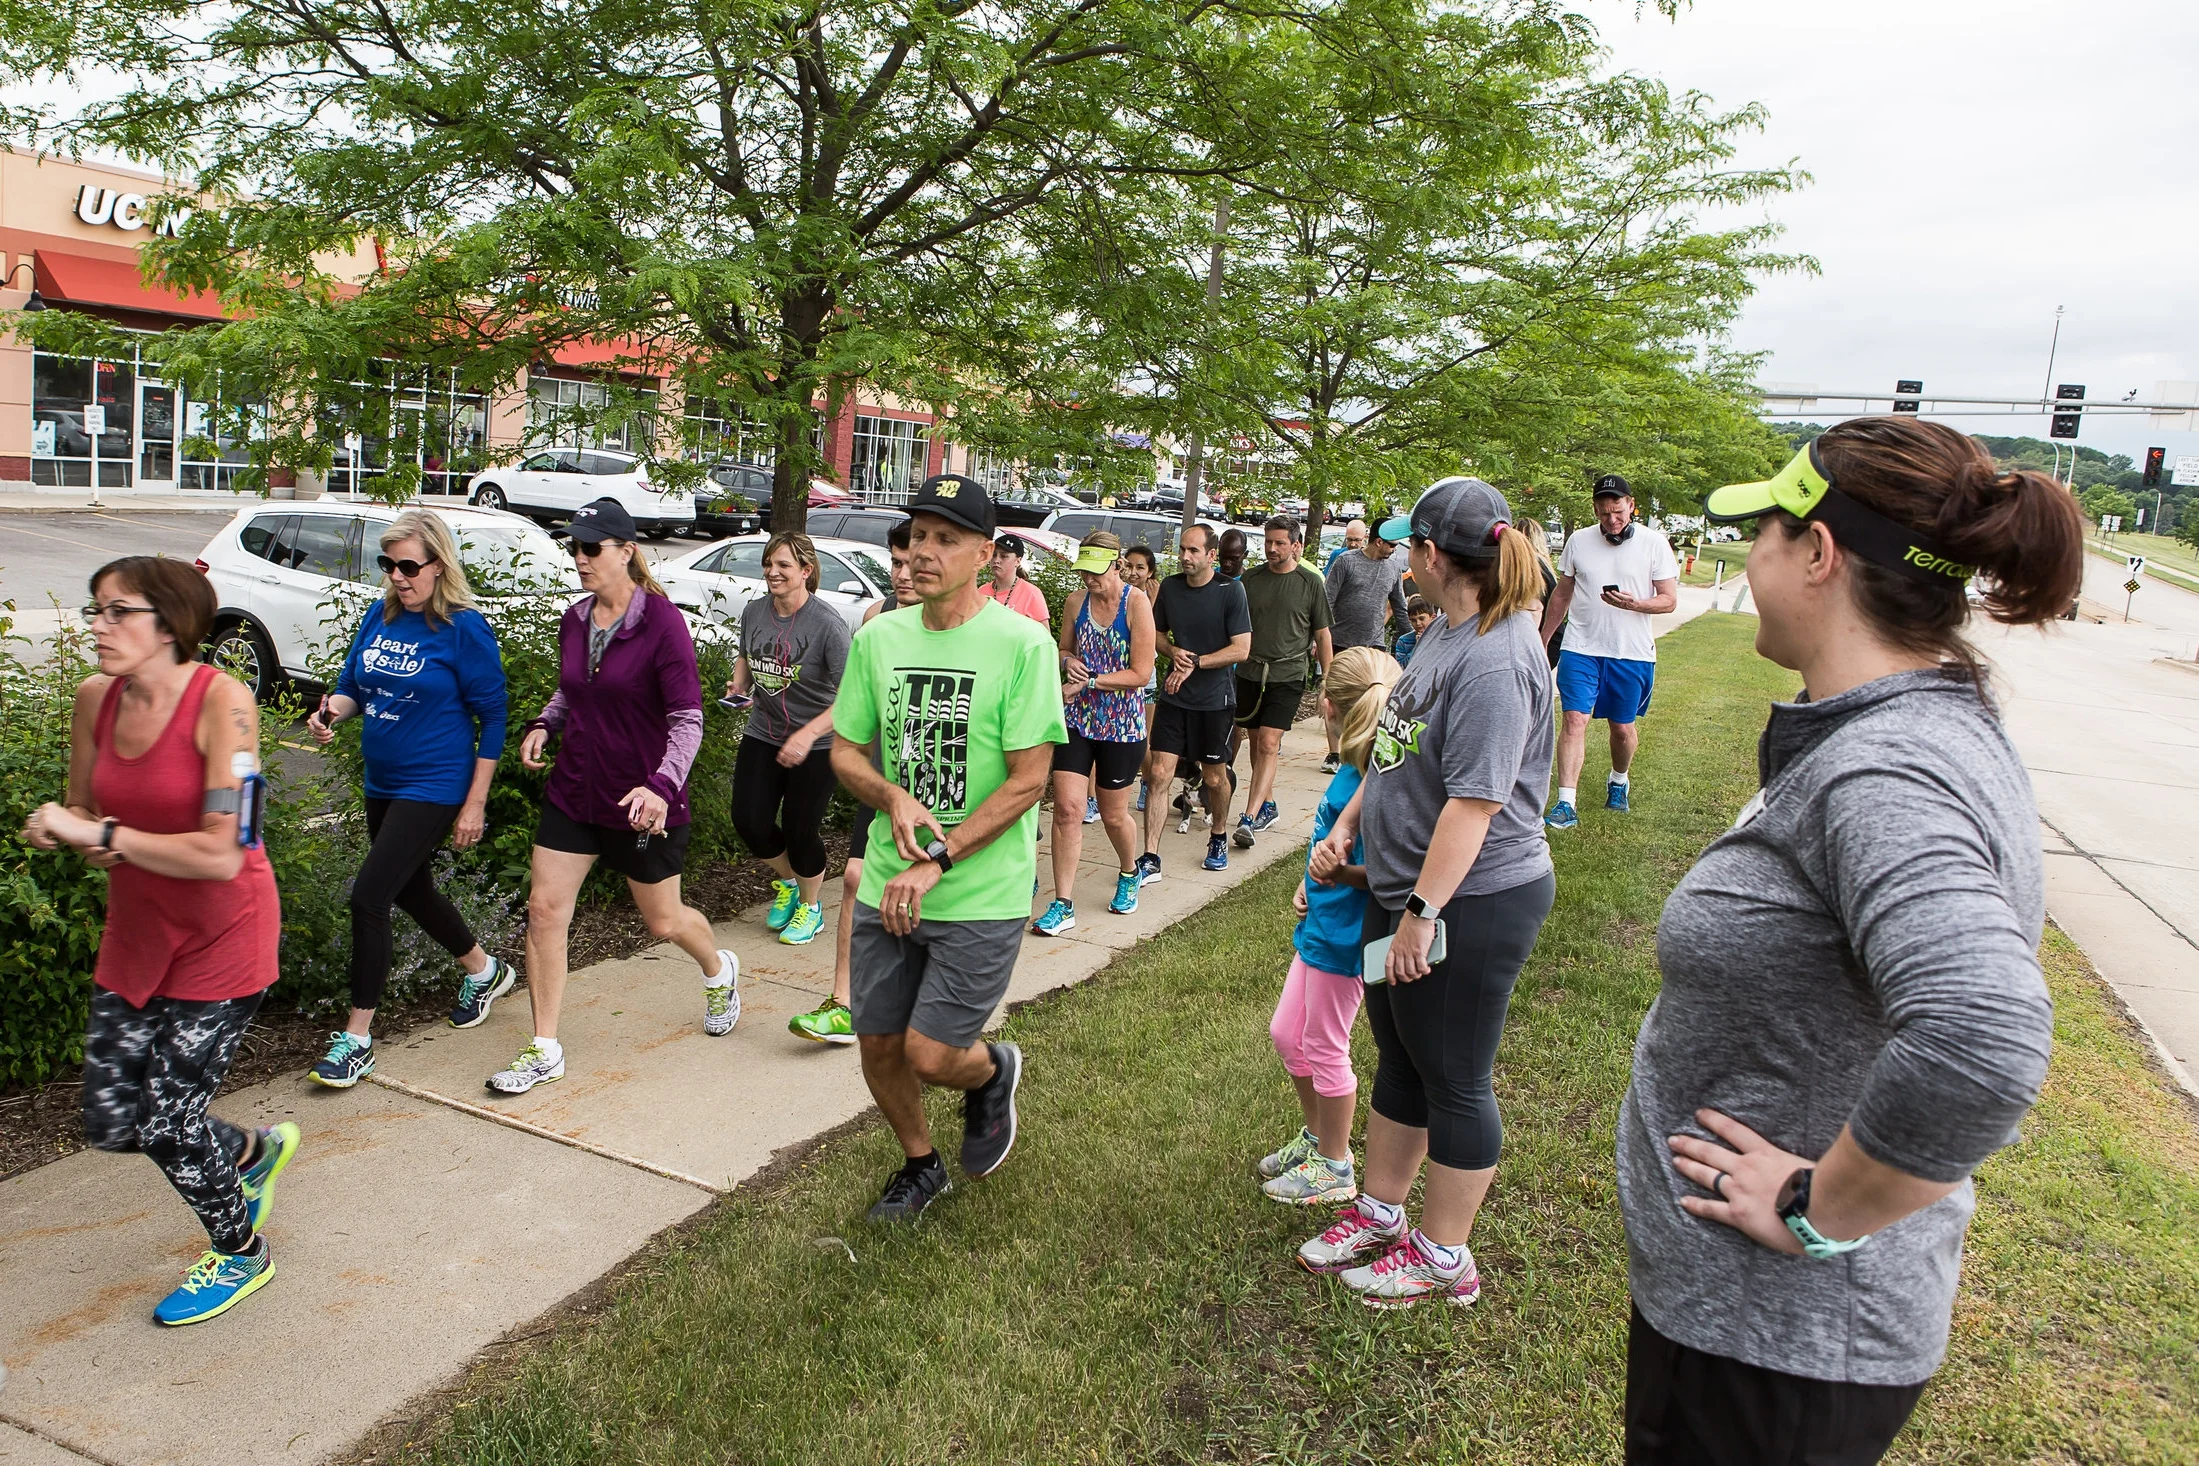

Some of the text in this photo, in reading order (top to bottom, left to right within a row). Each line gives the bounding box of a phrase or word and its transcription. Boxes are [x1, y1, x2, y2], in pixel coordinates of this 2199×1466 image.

[370, 635, 420, 655] heart
[376, 655, 418, 672] sle
[762, 662, 782, 675] WILD
[782, 666, 796, 677] 5K
[906, 674, 975, 721] TRI
[1396, 719, 1417, 744] 5K
